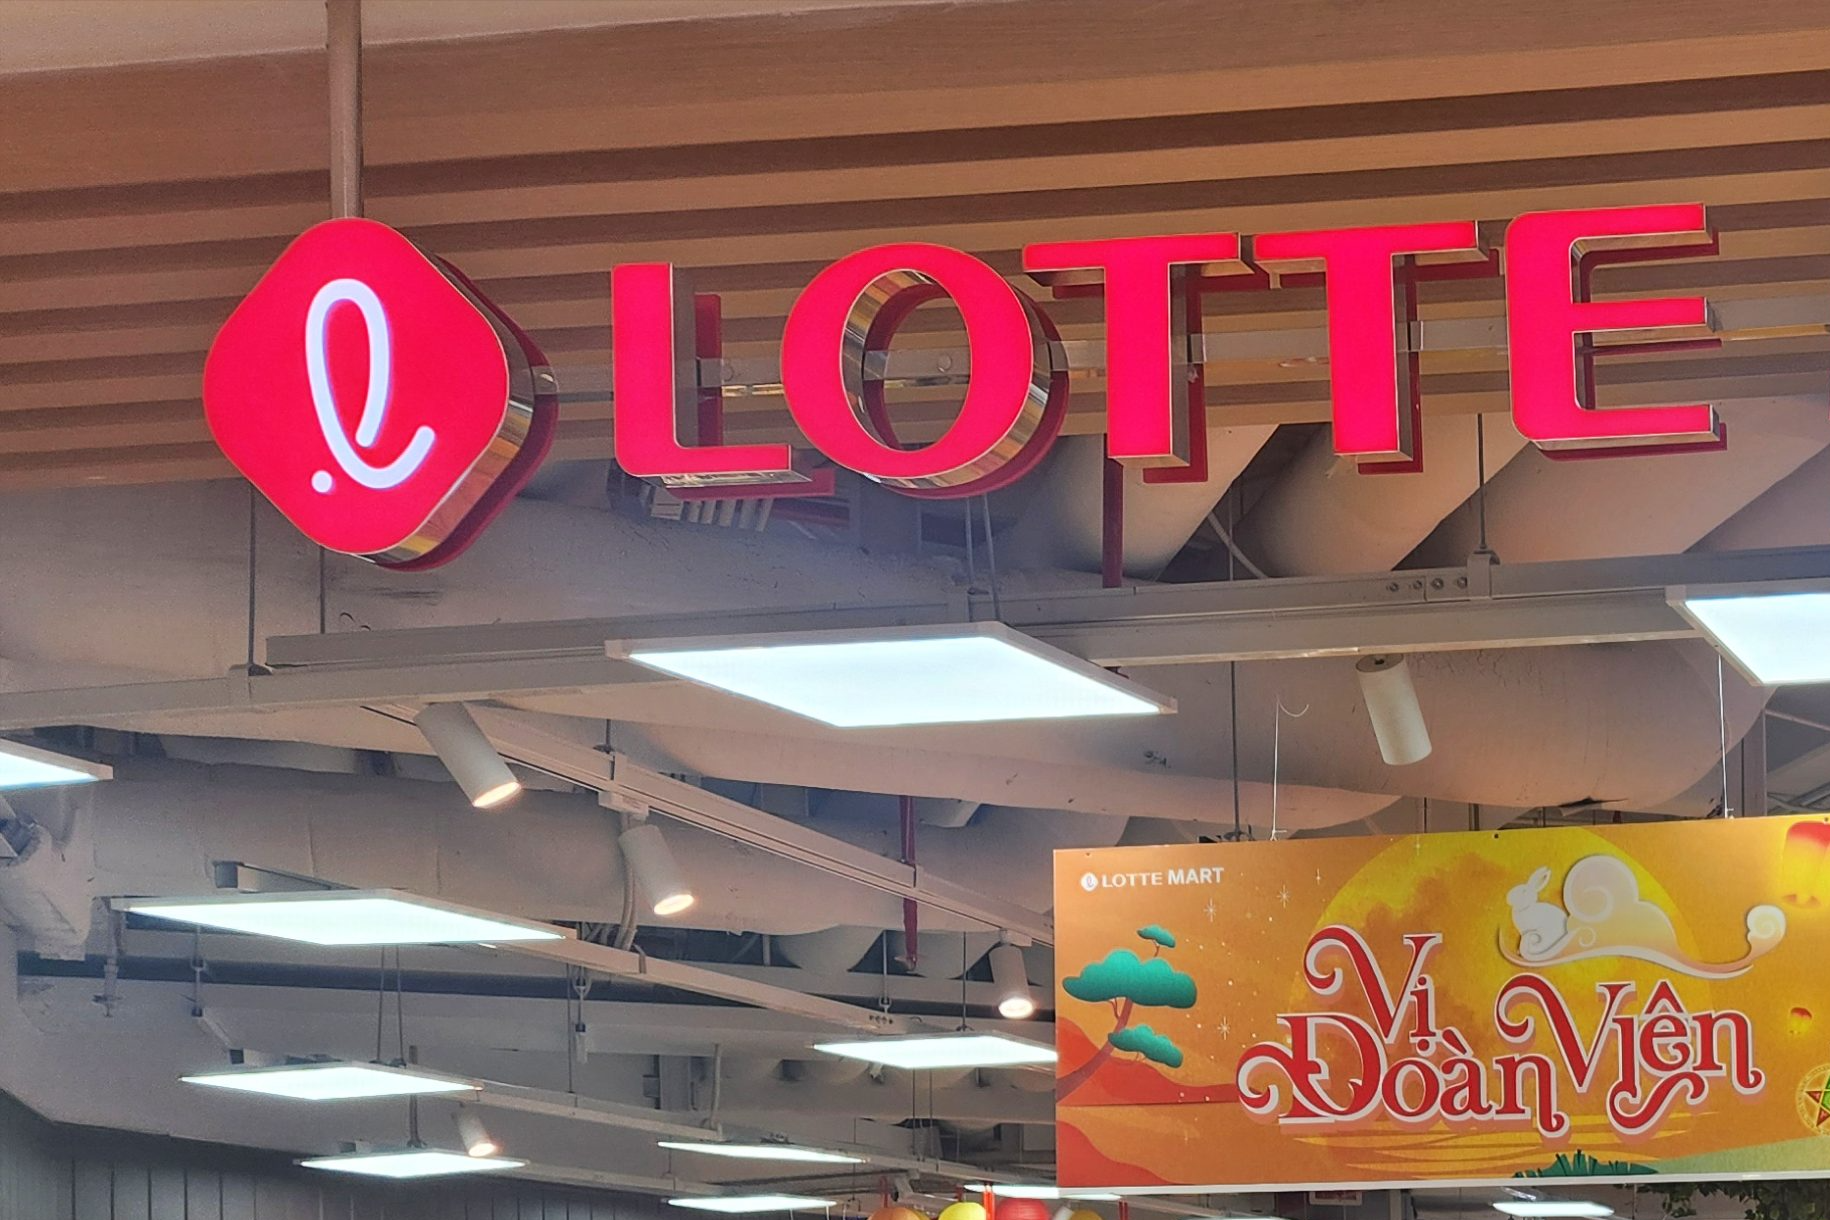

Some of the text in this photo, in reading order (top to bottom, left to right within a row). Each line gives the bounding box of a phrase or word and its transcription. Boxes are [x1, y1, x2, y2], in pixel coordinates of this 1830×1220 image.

[611, 202, 1722, 486] LOTTE
[1102, 866, 1225, 888] LOTTE MART
[1303, 924, 1443, 1058] Vị
[1237, 1012, 1570, 1138] Đoàn
